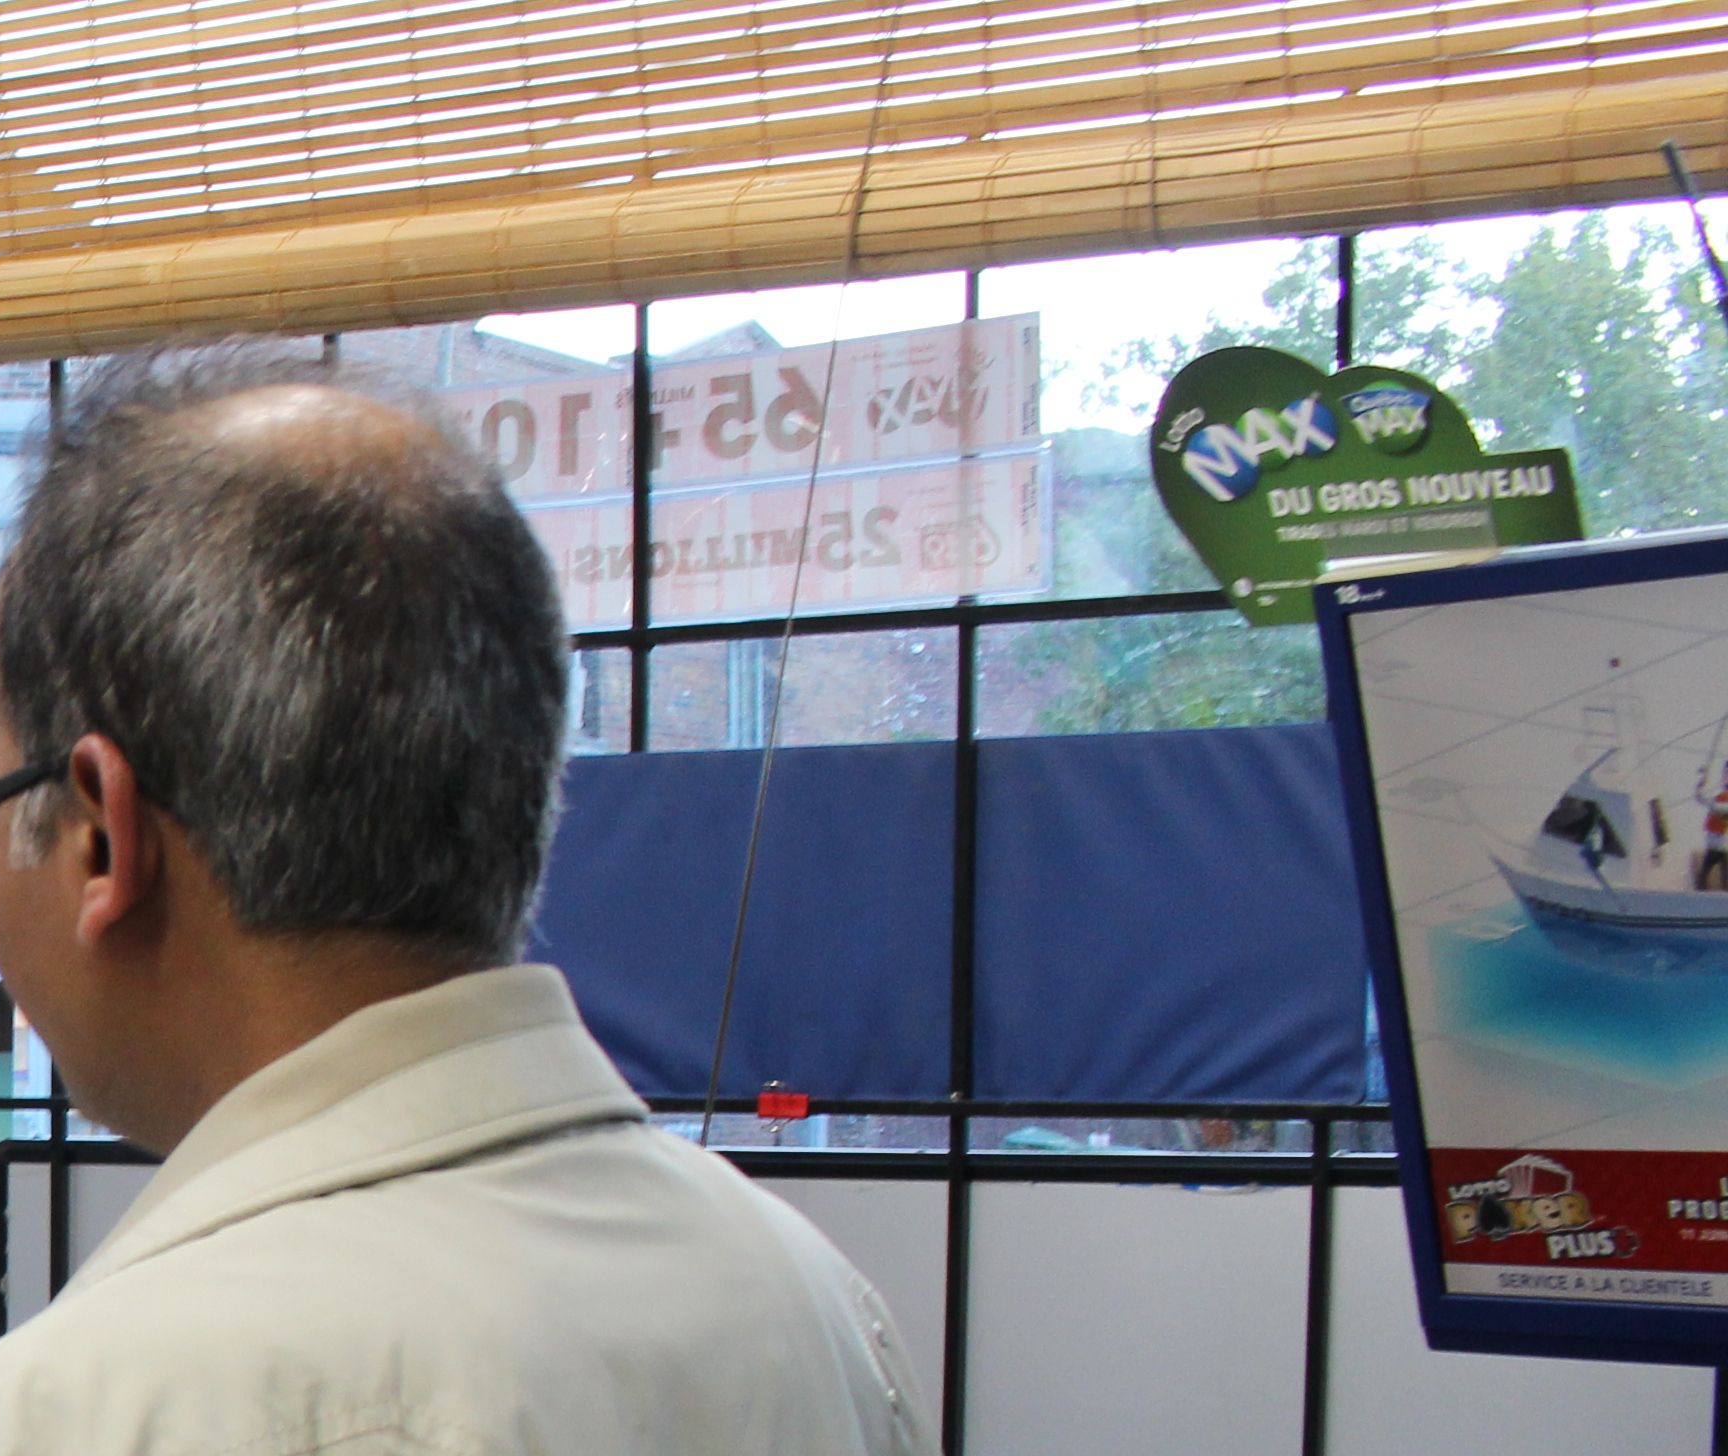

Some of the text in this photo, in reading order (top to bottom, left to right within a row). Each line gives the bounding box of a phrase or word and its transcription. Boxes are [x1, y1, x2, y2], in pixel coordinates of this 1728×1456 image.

[1352, 405, 1427, 444] MAX
[1181, 397, 1336, 502] MAX
[1266, 464, 1554, 518] DU GROS NOUVEAU
[1547, 1231, 1614, 1259] PLUS
[1498, 1273, 1569, 1290] SERVICE
[1594, 1277, 1613, 1292] LA
